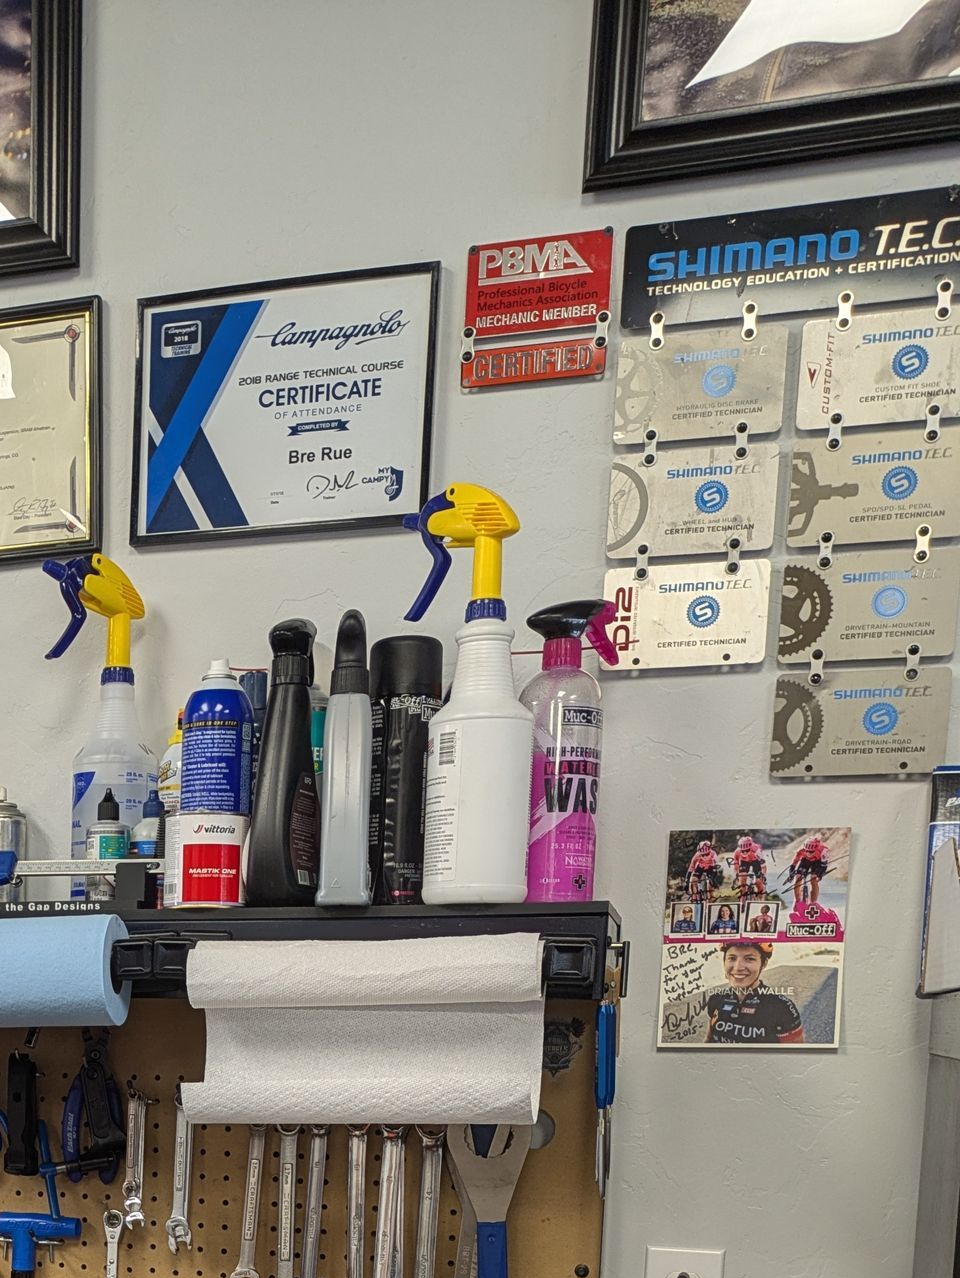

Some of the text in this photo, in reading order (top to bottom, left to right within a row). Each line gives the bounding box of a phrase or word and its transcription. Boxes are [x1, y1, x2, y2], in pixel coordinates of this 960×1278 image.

[478, 239, 585, 279] PBMA
[647, 228, 860, 282] SHIMANO
[647, 276, 742, 297] TECHNOLOGY
[746, 267, 830, 287] EDUCATION
[848, 252, 960, 274] CERTIFICATION
[477, 278, 587, 301] Professional Bicycle
[477, 288, 598, 313] Mechanics Association
[475, 304, 597, 329] MECHANIC MEMBER
[256, 309, 410, 350] Campagnolo
[862, 327, 934, 345] SHIMANO
[473, 345, 594, 380] CERTIFIED
[239, 360, 404, 386] 2018 RANGE TECHNICAL COURSE
[822, 333, 836, 415] CUSTOM-FIT
[258, 378, 382, 408] CERTIFICATE
[875, 381, 941, 394] CUSTOM FIT SHOE
[859, 388, 956, 403] CERTIFIED TECHNICIAN
[274, 404, 362, 420] OF ATTENDANCE
[672, 406, 763, 420] CERTIFIED TECHNICIAN
[297, 422, 330, 432] COMPLETED
[288, 446, 353, 464] Bre Rue
[851, 449, 923, 466] SHIMANO
[361, 475, 390, 484] CAMPY
[667, 464, 733, 480] SHIMANO
[682, 517, 707, 527] WHEEL
[849, 510, 945, 523] CERTIFIED TECHNICIAN
[664, 522, 754, 536] CERTIFIED TECHNICIAN
[842, 571, 914, 584] SHIMANO
[659, 580, 724, 594] SHIMANO
[840, 627, 935, 640] CERTIFIED TECHNICIAN
[845, 621, 931, 631] DRIVETRAIN-MOUNTAIN
[657, 637, 747, 649] CERTIFIED TECHNICIAN
[833, 687, 902, 700] SHIMANO
[845, 739, 912, 748] DRIVETRAIN-ROAD
[831, 746, 926, 757] CERTIFIED TECHNICIAN
[204, 824, 236, 834] vittoria
[5, 902, 23, 911] the
[28, 902, 50, 911] Gap
[54, 901, 101, 911] Designs
[789, 924, 834, 937] Muc-Off
[663, 957, 697, 975] Thank
[664, 964, 704, 986] for your
[665, 973, 702, 995] help and
[708, 987, 794, 995] BRIANNA WALLE
[715, 1021, 766, 1038] OPTUM
